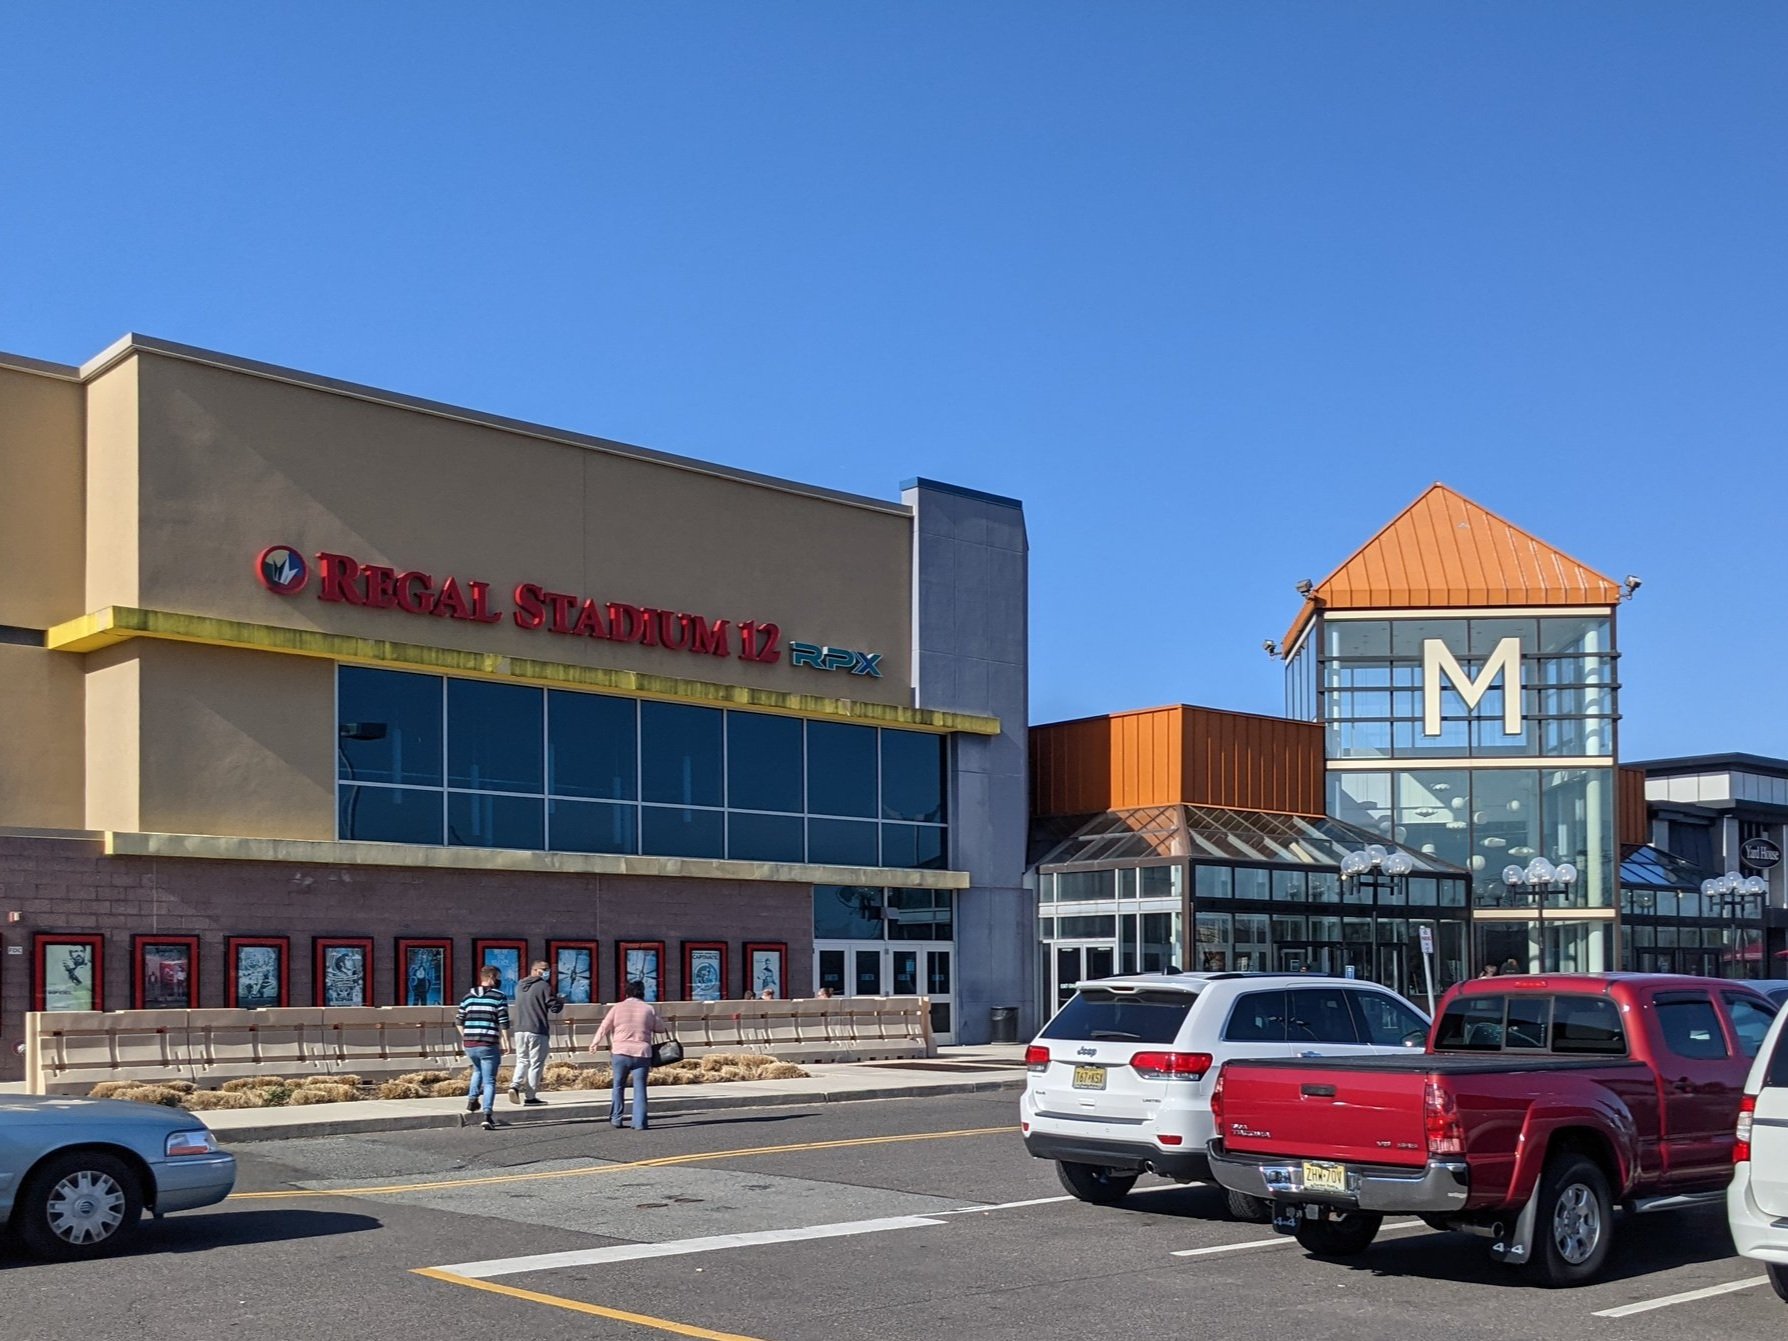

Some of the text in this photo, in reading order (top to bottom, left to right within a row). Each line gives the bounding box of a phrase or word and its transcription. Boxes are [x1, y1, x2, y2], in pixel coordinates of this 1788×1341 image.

[315, 551, 781, 663] REGAL STADIUM 12
[789, 641, 884, 678] RPX
[1423, 637, 1522, 736] M
[1744, 844, 1779, 860] Yard House
[1077, 1046, 1097, 1058] Jeep
